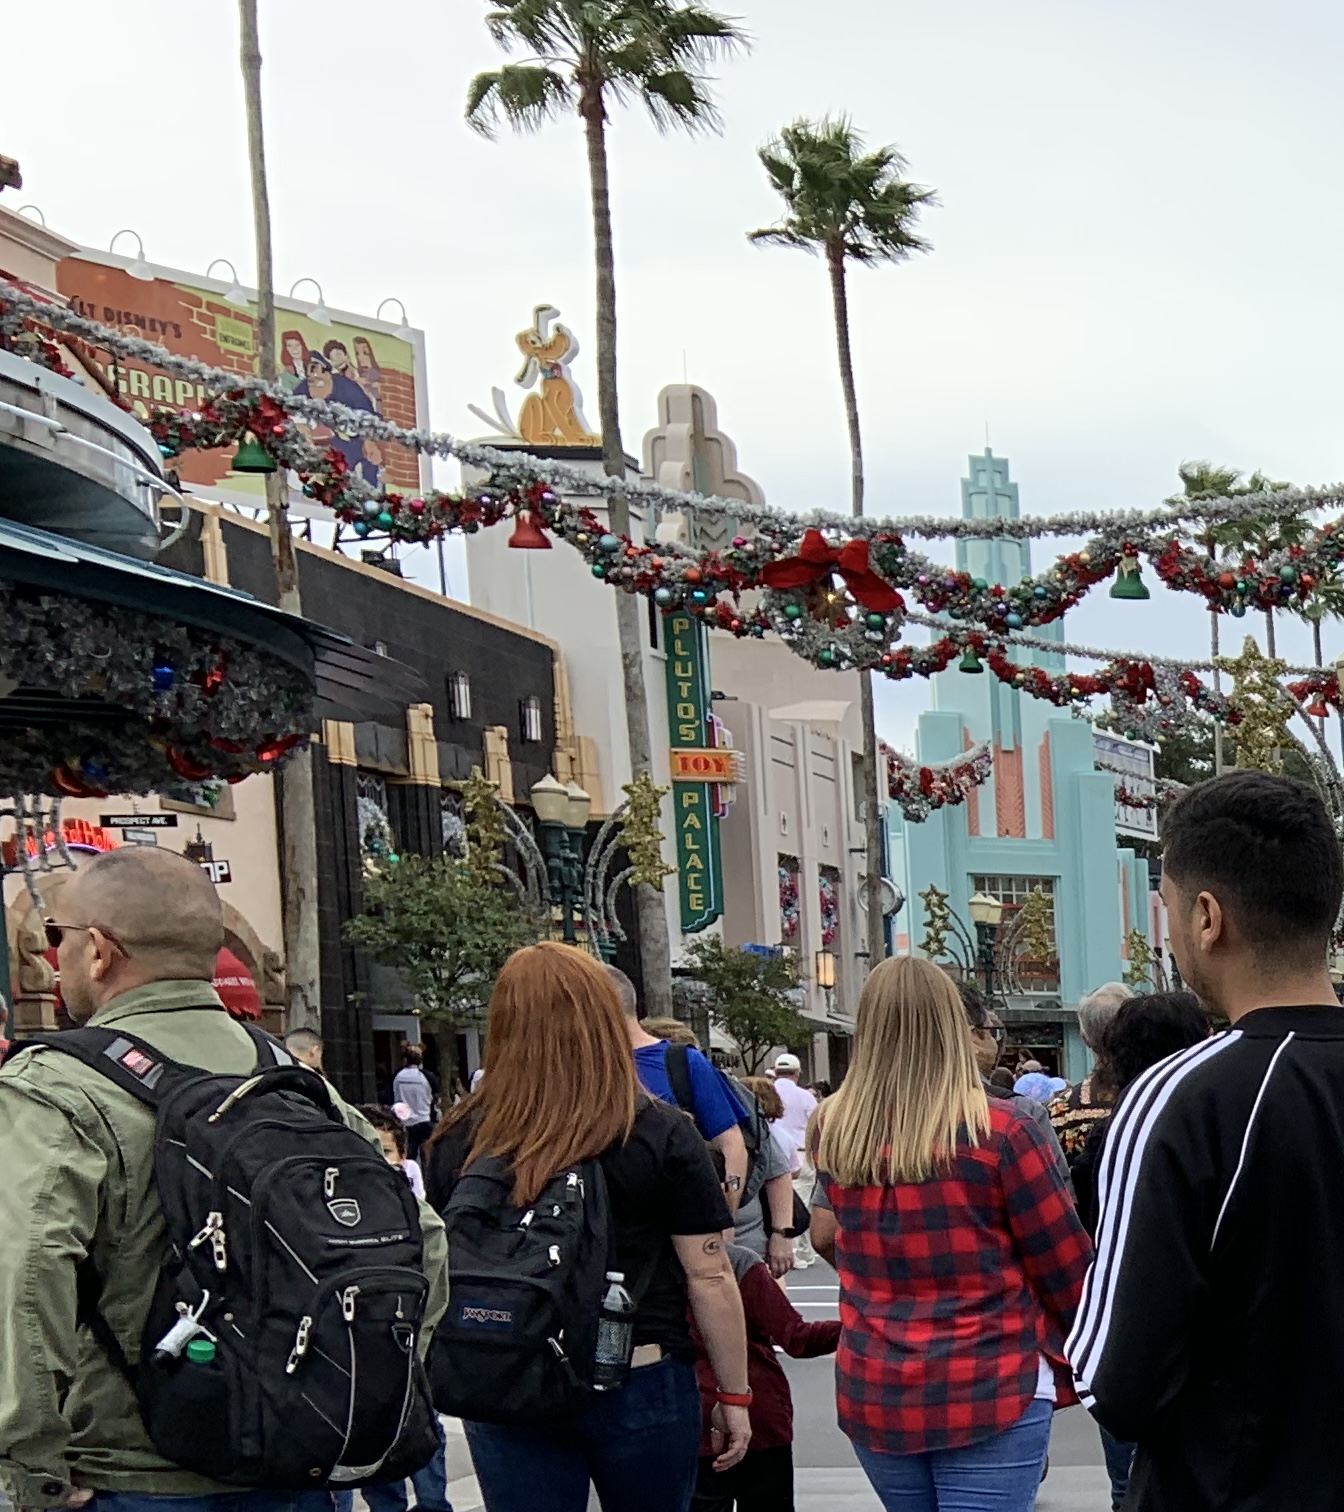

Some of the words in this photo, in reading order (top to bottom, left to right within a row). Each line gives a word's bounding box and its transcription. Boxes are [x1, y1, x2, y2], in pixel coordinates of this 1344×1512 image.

[672, 617, 700, 742] PLUTO'S
[679, 754, 725, 775] TOY
[682, 791, 705, 912] PALACE
